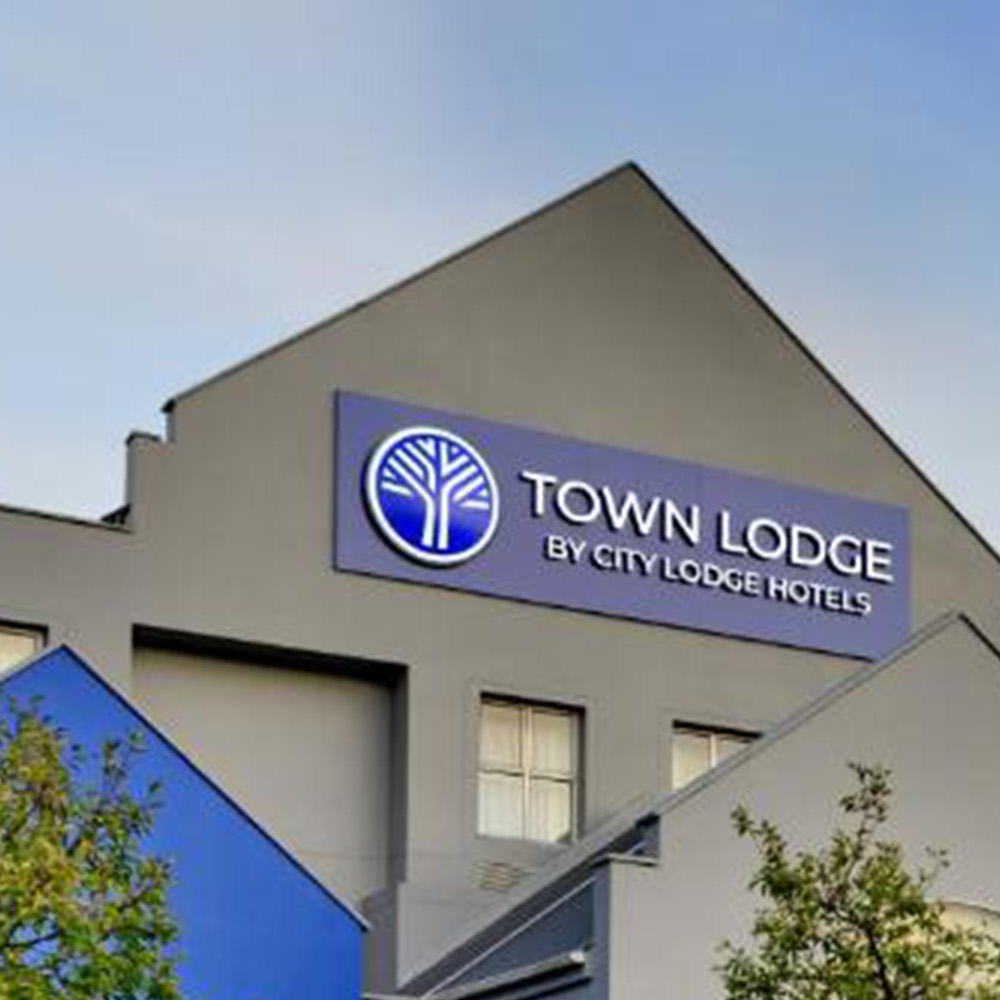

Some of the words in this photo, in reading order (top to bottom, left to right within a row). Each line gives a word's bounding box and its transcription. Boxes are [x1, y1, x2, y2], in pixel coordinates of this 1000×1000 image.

[521, 470, 700, 543] TOWN
[720, 510, 895, 582] LODGE
[546, 535, 587, 563] BY
[593, 544, 658, 575] CITY
[664, 555, 761, 596] LODGE
[767, 576, 873, 616] HOTELS
